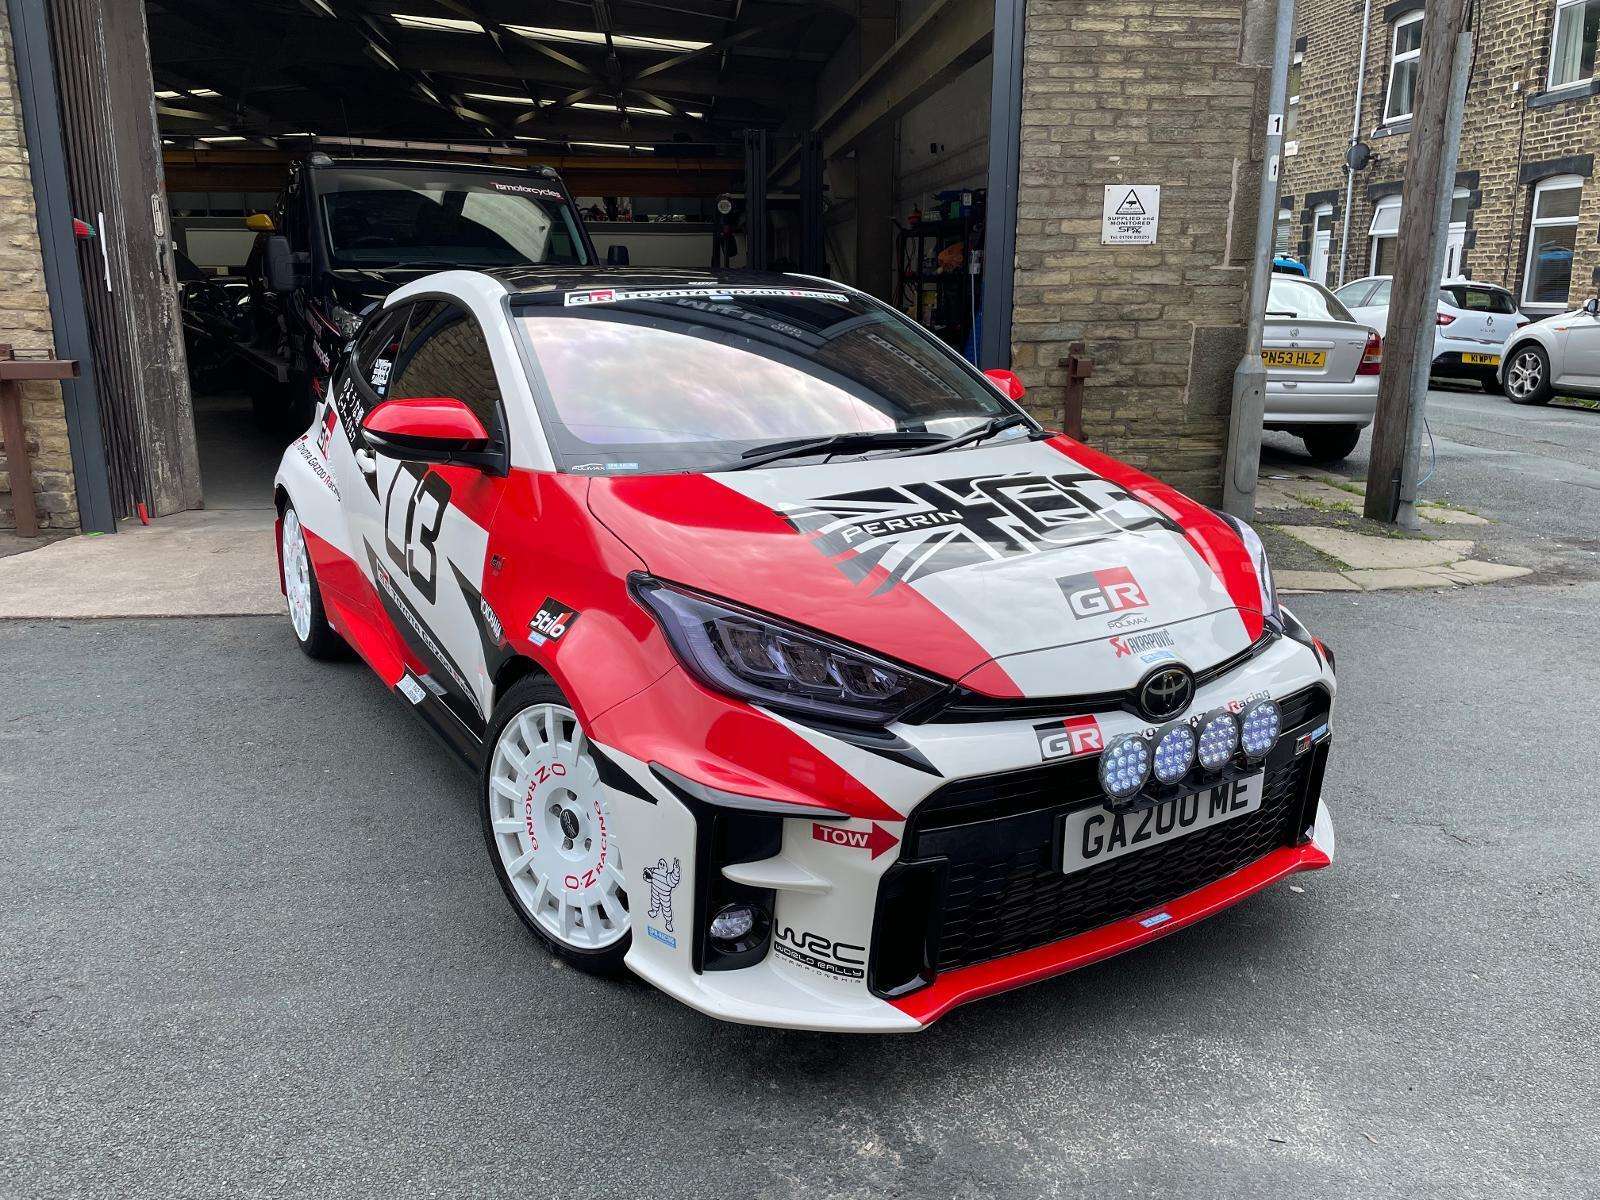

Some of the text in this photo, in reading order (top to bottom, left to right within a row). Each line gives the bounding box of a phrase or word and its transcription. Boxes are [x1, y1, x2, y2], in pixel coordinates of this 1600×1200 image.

[1274, 116, 1281, 133] 1
[1273, 164, 1277, 176] 1
[625, 289, 709, 300] TOYOTA
[715, 288, 785, 297] GAZOO
[1261, 351, 1321, 365] PN53 HLZ
[308, 456, 328, 479] GAZOO
[841, 509, 964, 544] PERRIN
[529, 609, 568, 638] Stilo
[1208, 782, 1250, 819] ME
[525, 780, 539, 851] RACING
[820, 827, 869, 847] TOW
[774, 918, 866, 966] WRC
